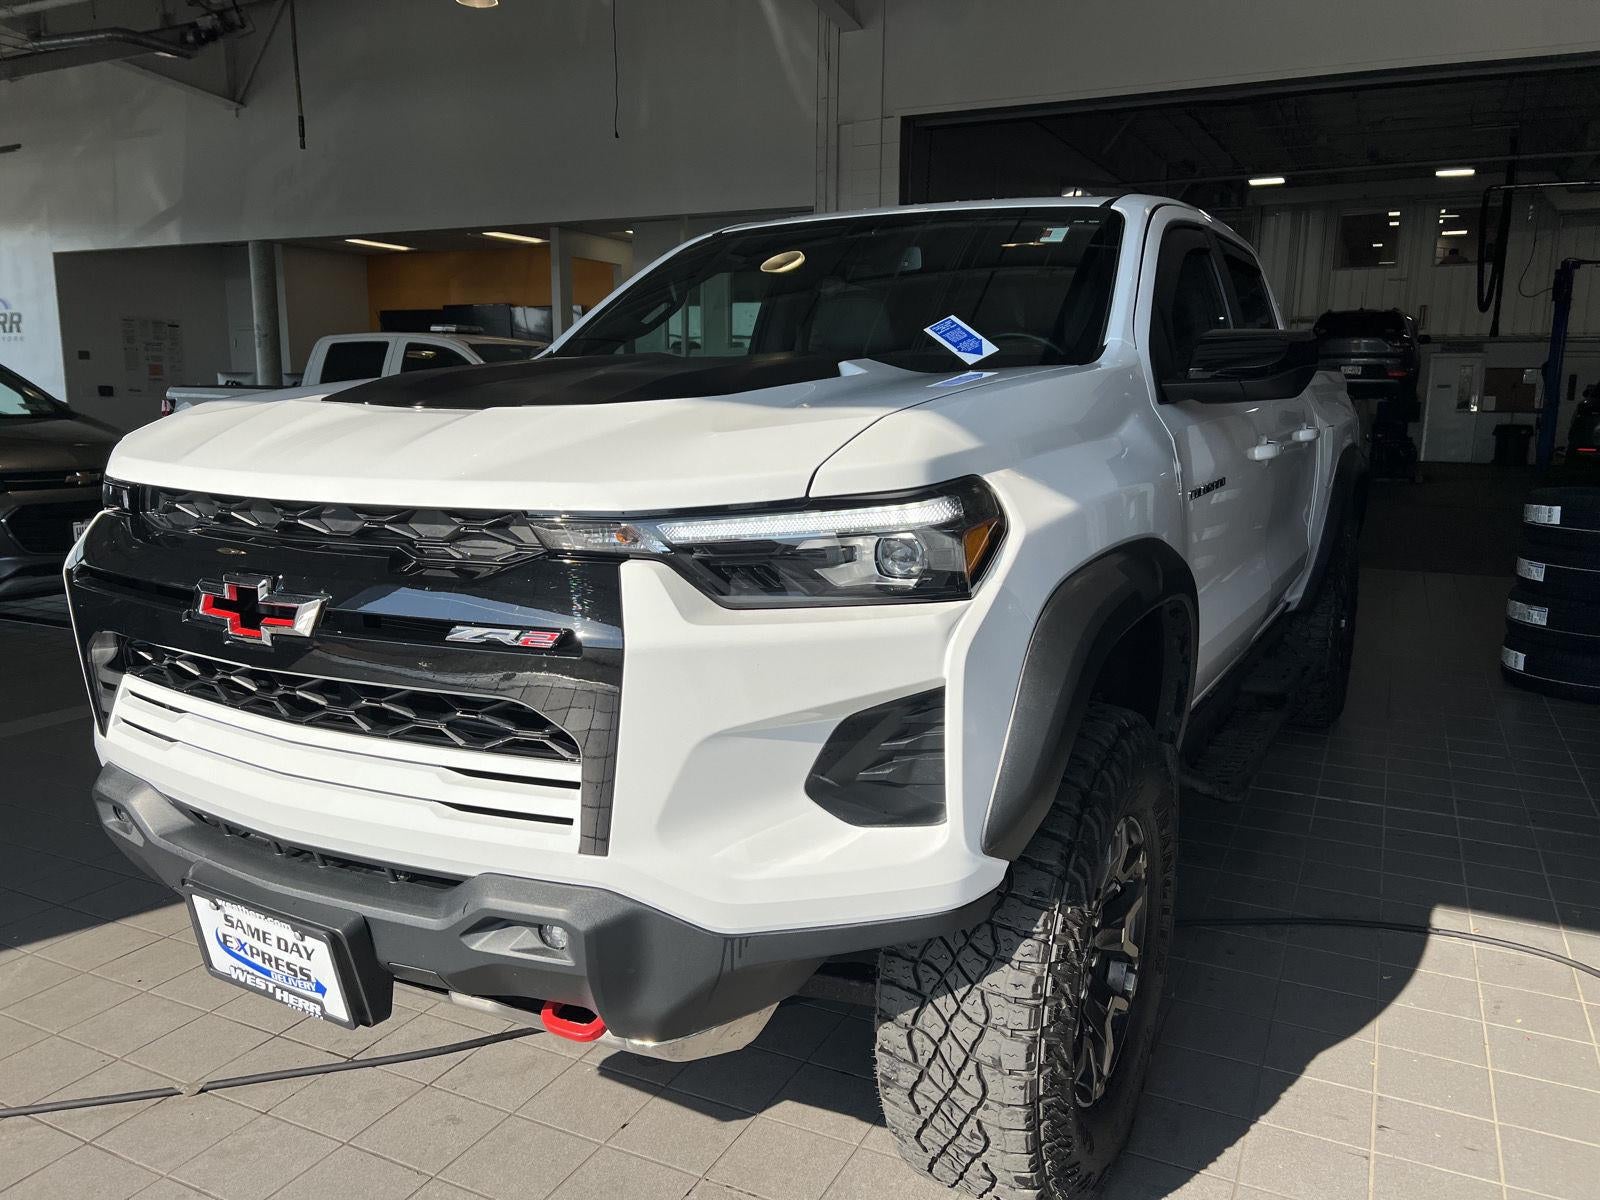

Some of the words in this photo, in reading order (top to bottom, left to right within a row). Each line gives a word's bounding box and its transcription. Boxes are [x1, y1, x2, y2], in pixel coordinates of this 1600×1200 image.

[446, 626, 561, 648] ZR2
[223, 933, 312, 982] EXPRESS
[224, 914, 272, 946] SAME
[277, 936, 315, 961] DAY
[229, 967, 276, 993] WEST
[276, 989, 322, 1015] HERR
[271, 972, 316, 991] DELIVERY
